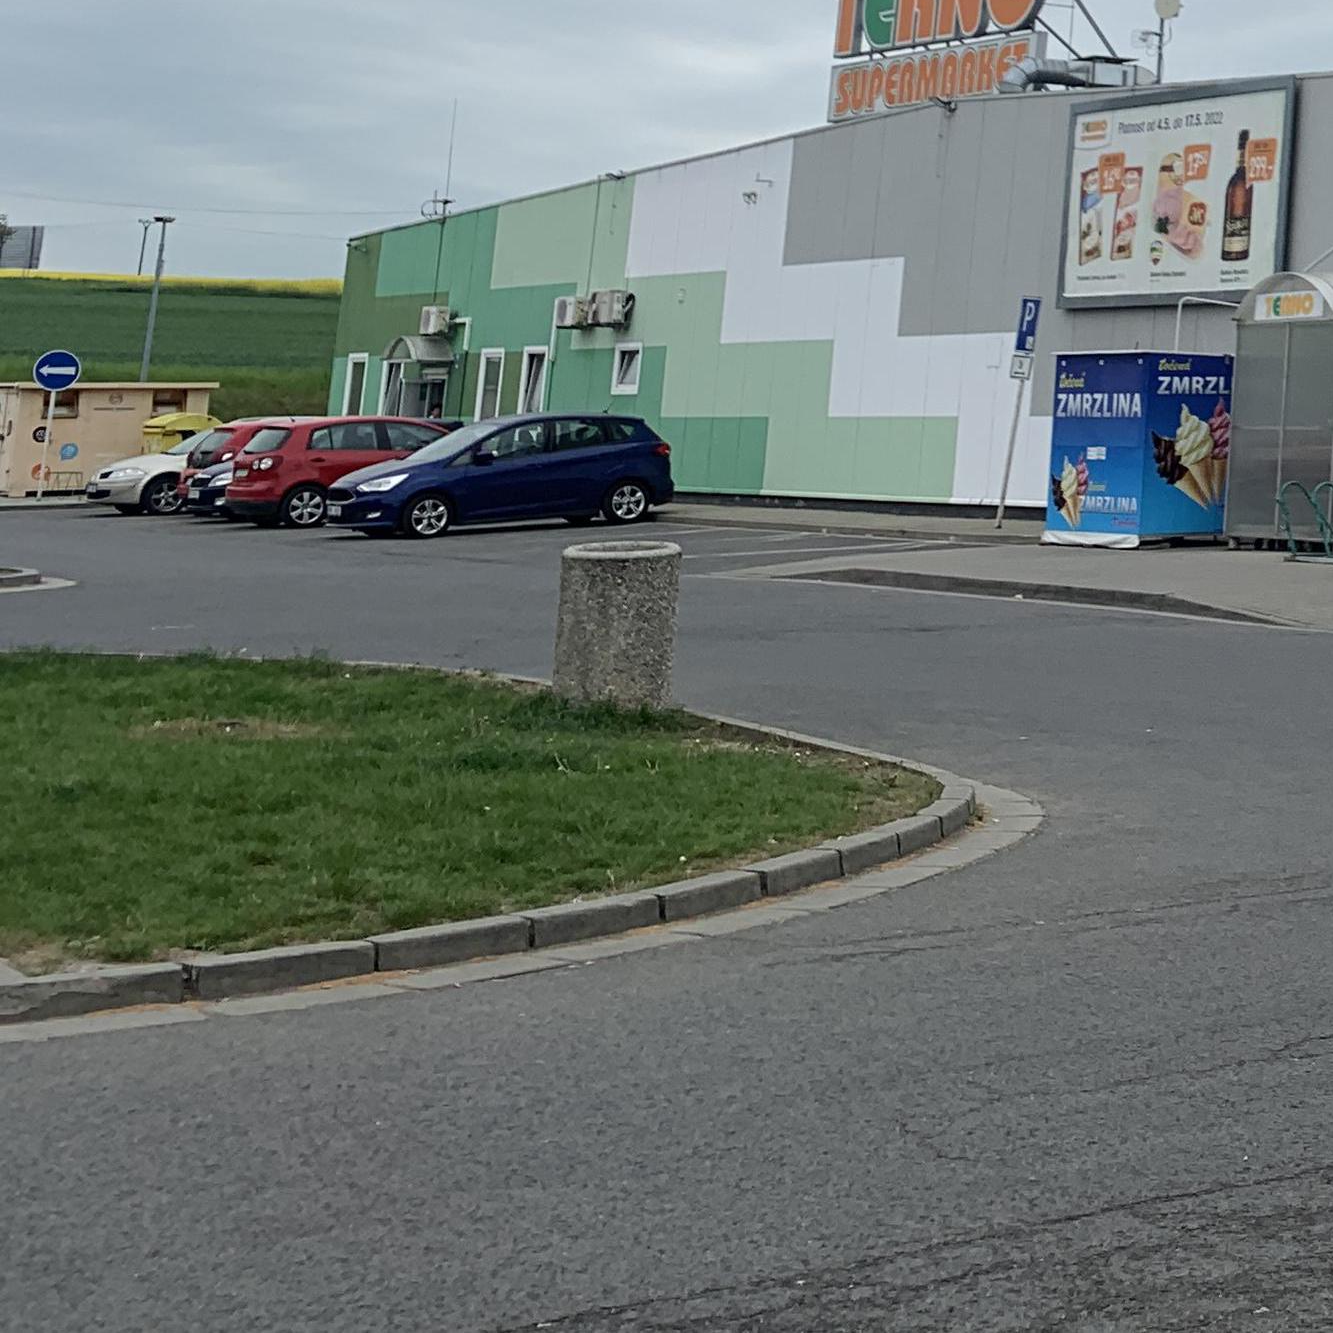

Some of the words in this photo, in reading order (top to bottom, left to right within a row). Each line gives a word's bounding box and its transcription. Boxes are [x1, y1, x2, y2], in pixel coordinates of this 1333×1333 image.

[1023, 302, 1035, 332] P
[1156, 376, 1231, 395] ZMRZL
[1056, 393, 1142, 417] ZMRZLINA
